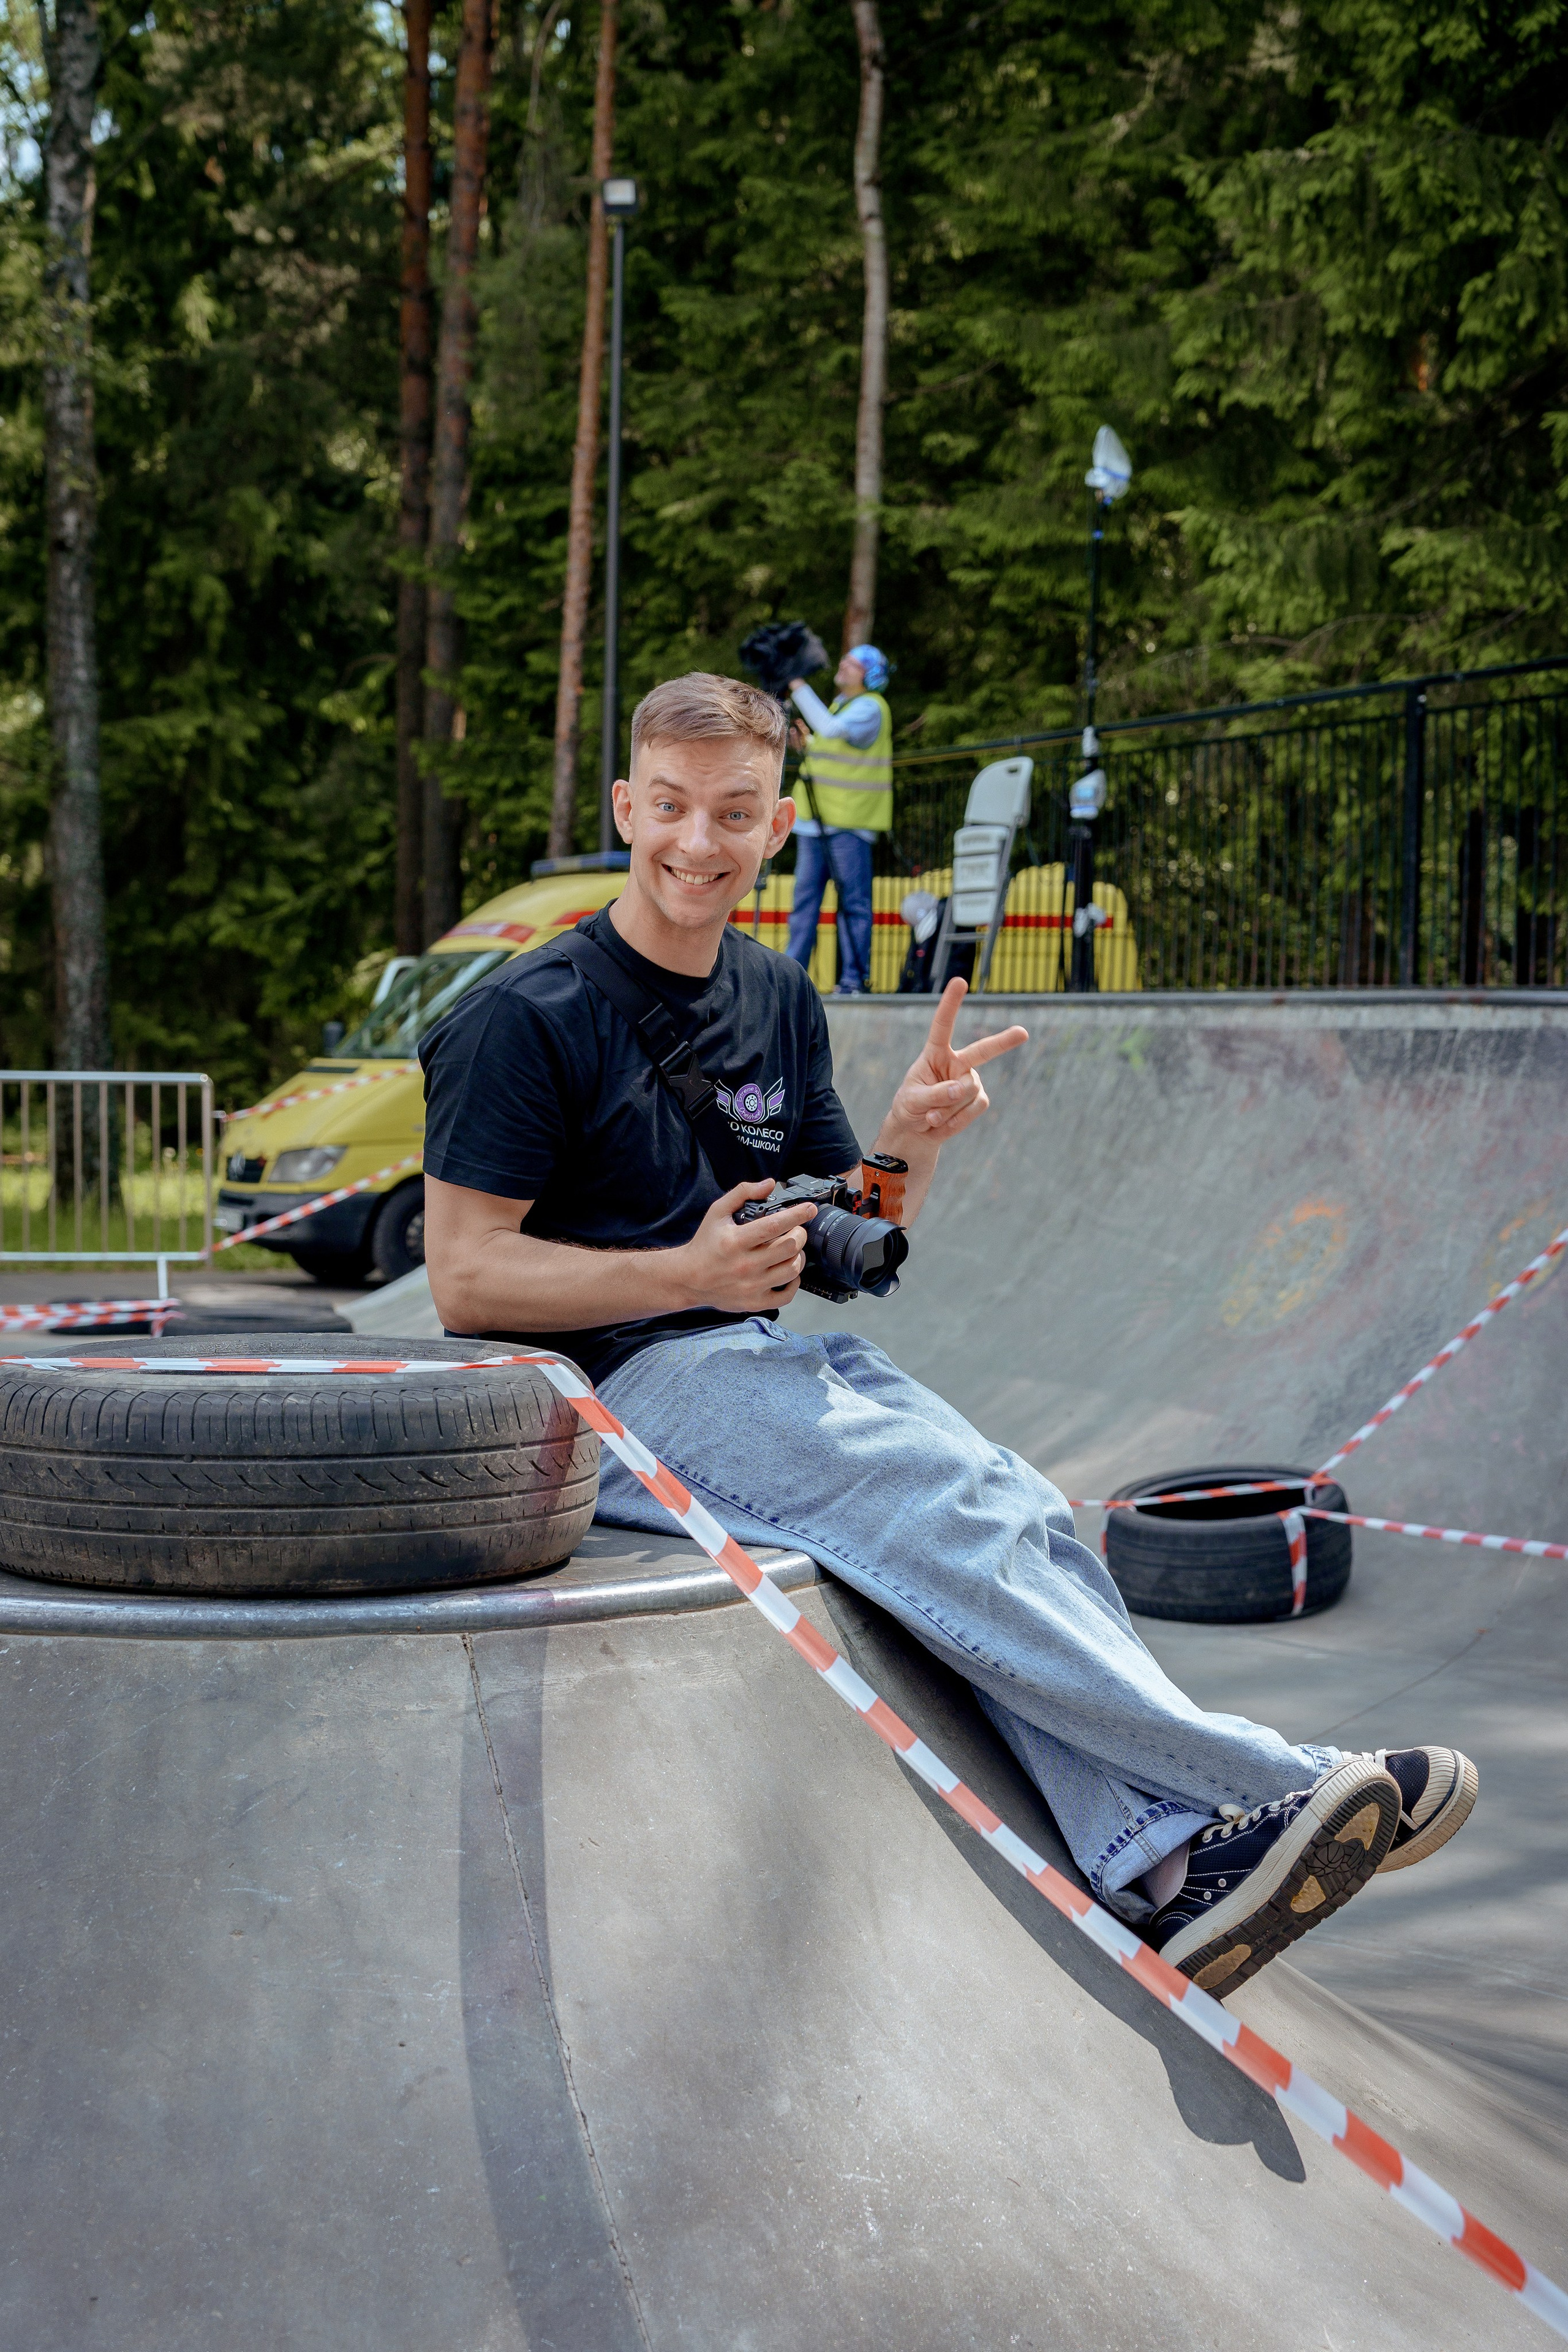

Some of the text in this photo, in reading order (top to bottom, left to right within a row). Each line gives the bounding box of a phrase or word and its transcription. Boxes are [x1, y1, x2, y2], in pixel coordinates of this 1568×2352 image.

[736, 1087, 754, 1102] Extreme
[739, 1107, 761, 1120] OneWheel
[741, 1124, 784, 1141] КОЛЕСО
